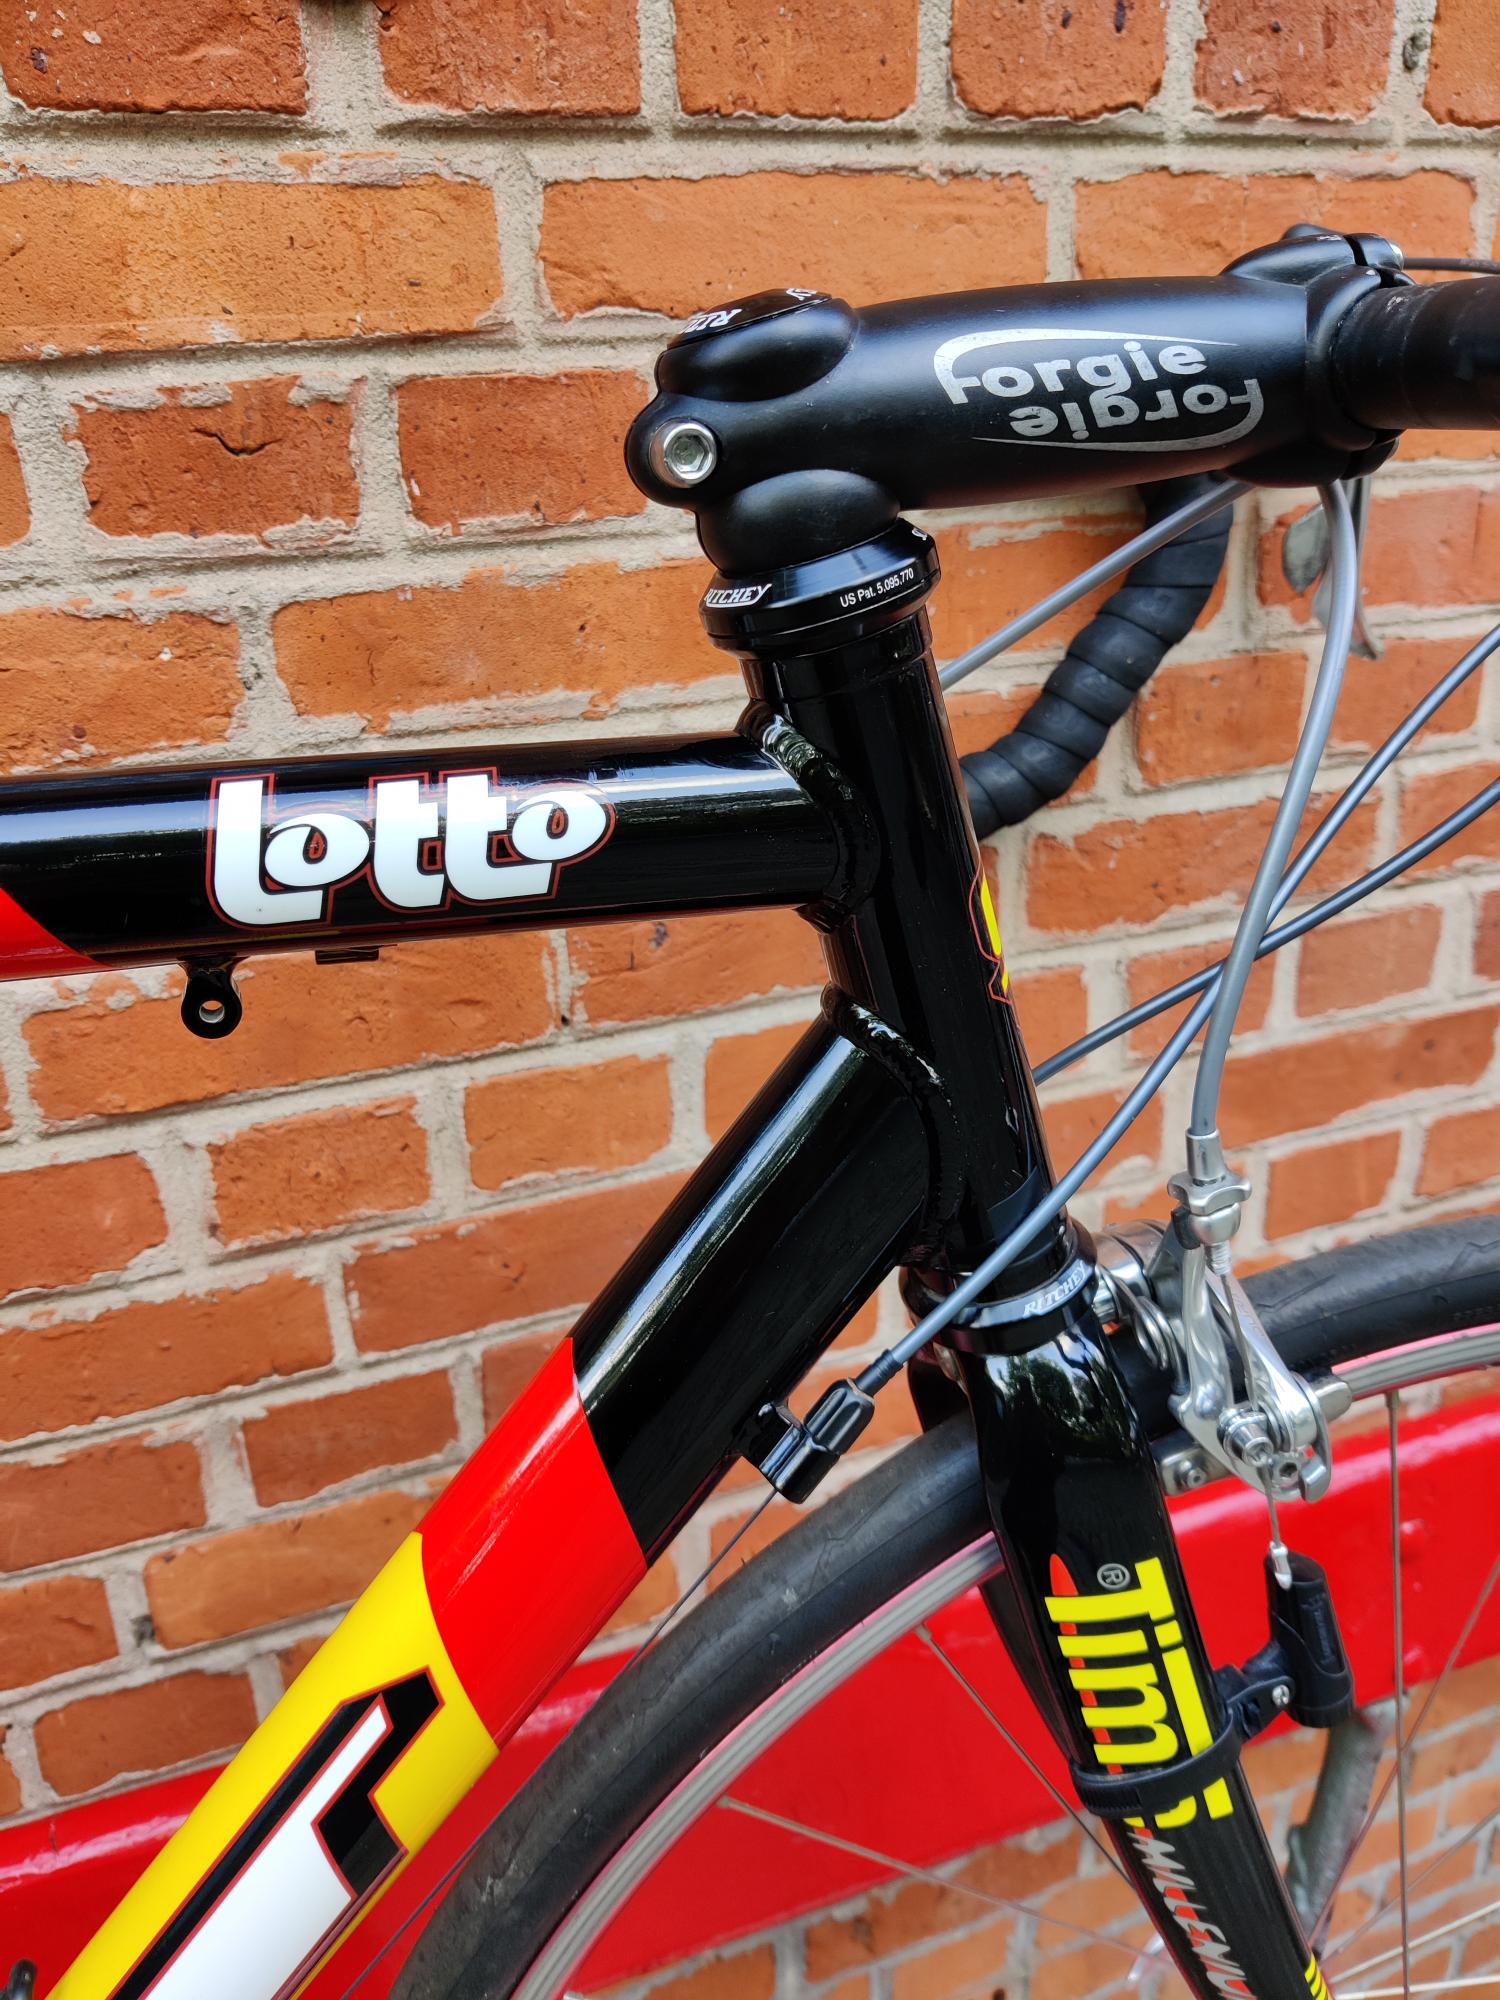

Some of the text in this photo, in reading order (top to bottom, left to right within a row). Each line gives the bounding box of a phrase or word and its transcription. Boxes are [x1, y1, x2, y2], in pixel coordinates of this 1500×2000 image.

[933, 328, 1238, 405] Forgie
[973, 378, 1264, 452] Forgie
[839, 592, 857, 608] US
[857, 586, 876, 602] Pat.
[207, 768, 615, 929] Lotto
[1023, 1259, 1086, 1319] RITCHEY
[1126, 1830, 1258, 2000] MILLENIU
